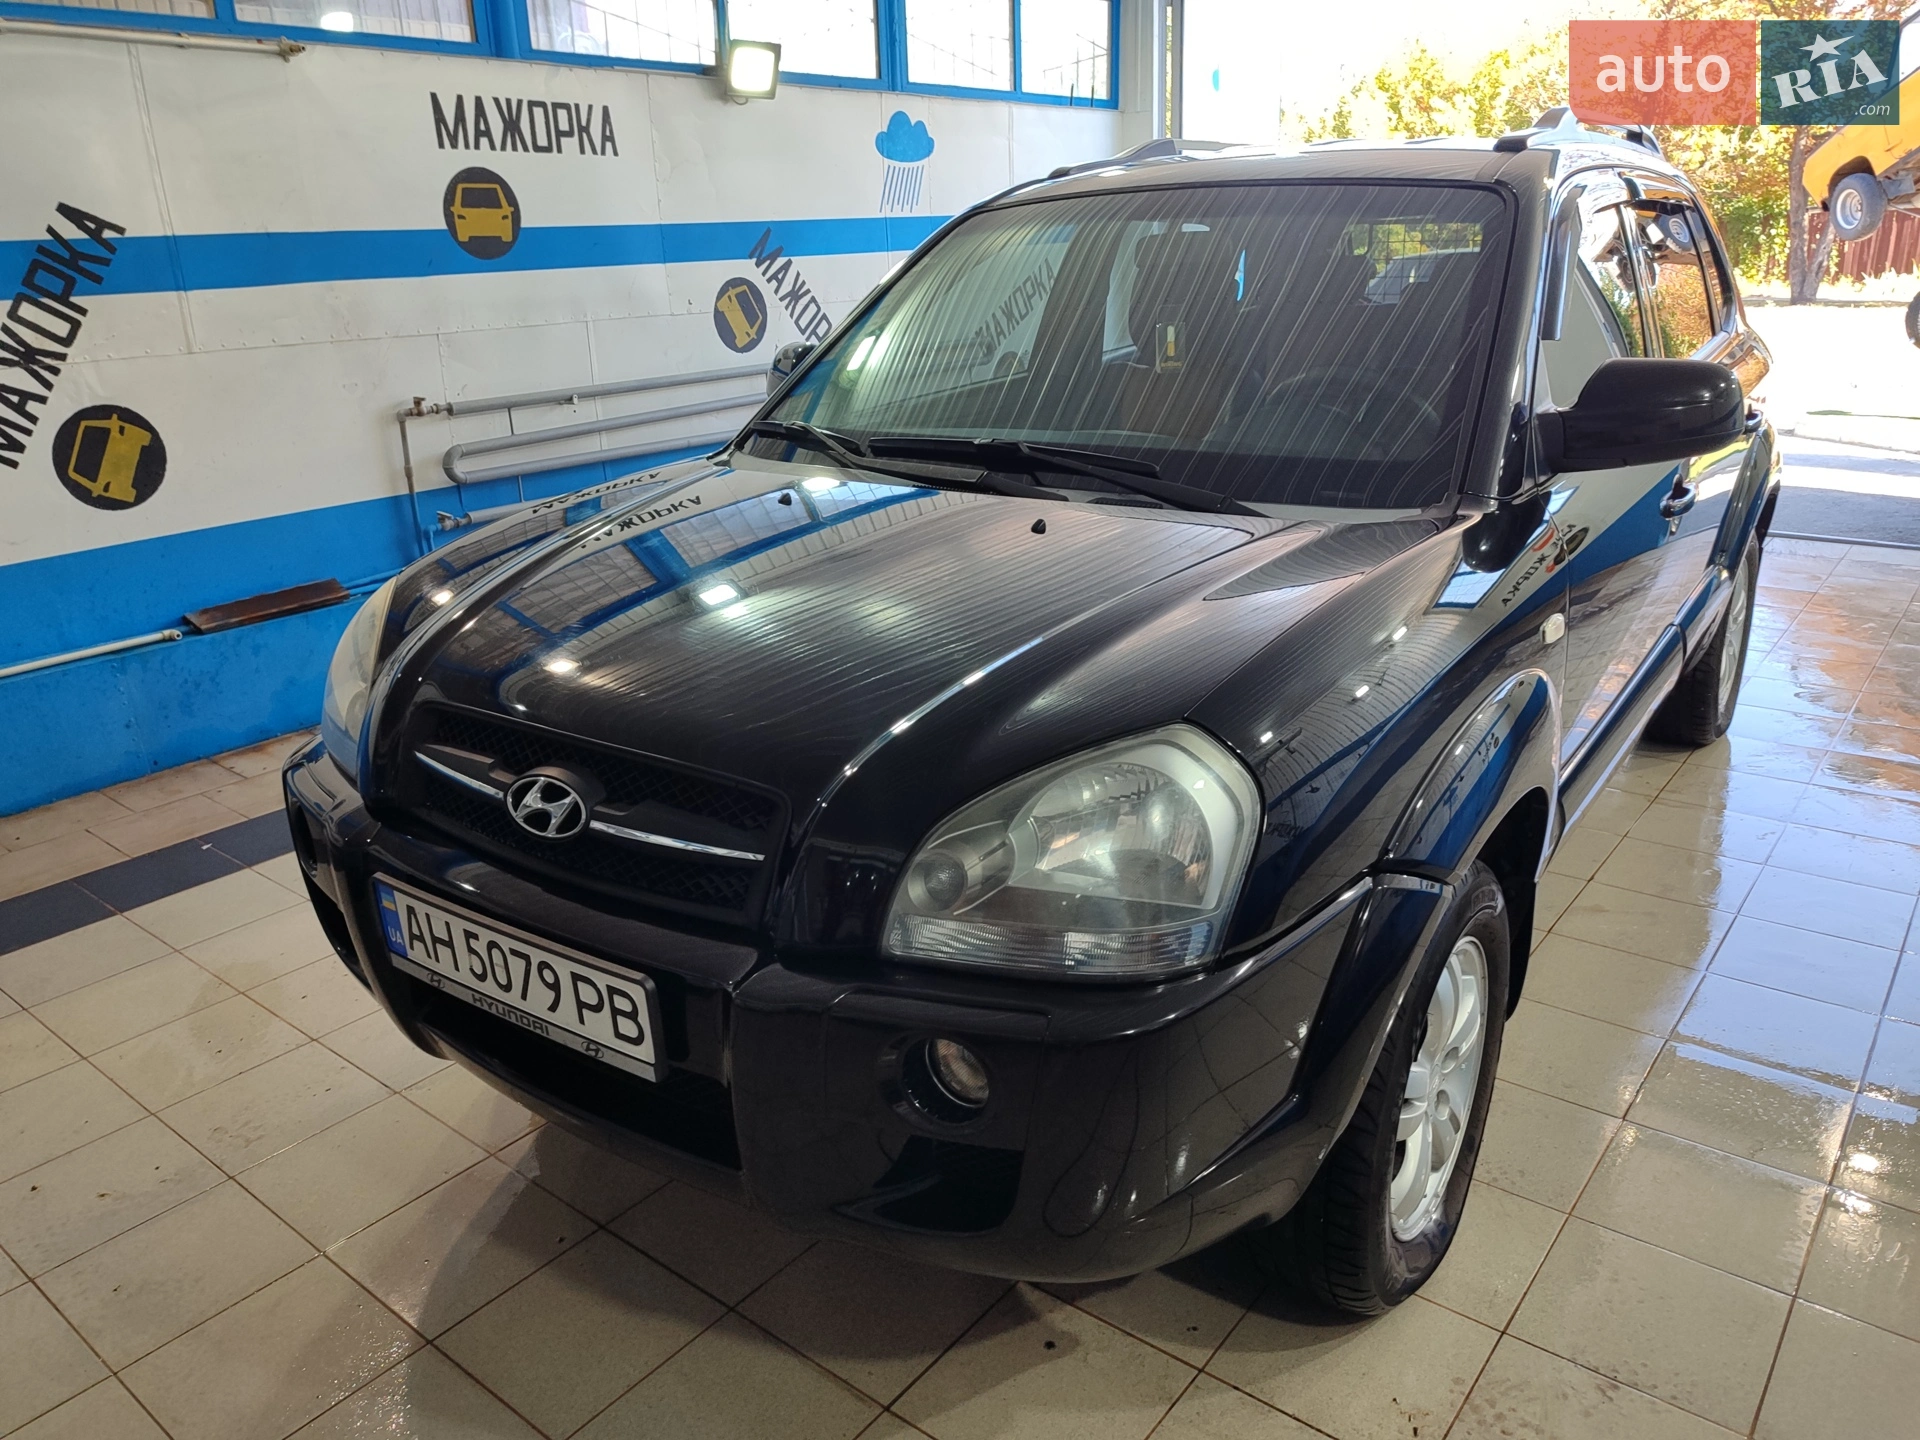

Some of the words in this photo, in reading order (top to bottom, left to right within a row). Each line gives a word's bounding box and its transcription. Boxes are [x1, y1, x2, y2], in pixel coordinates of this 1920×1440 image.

[429, 91, 620, 158] МАЖОРКА
[748, 226, 833, 344] МАЖОР
[387, 925, 405, 946] UA
[406, 903, 460, 973] AH
[463, 928, 562, 1014] 5079
[570, 970, 645, 1047] PB
[471, 993, 551, 1037] HYUNDAI
